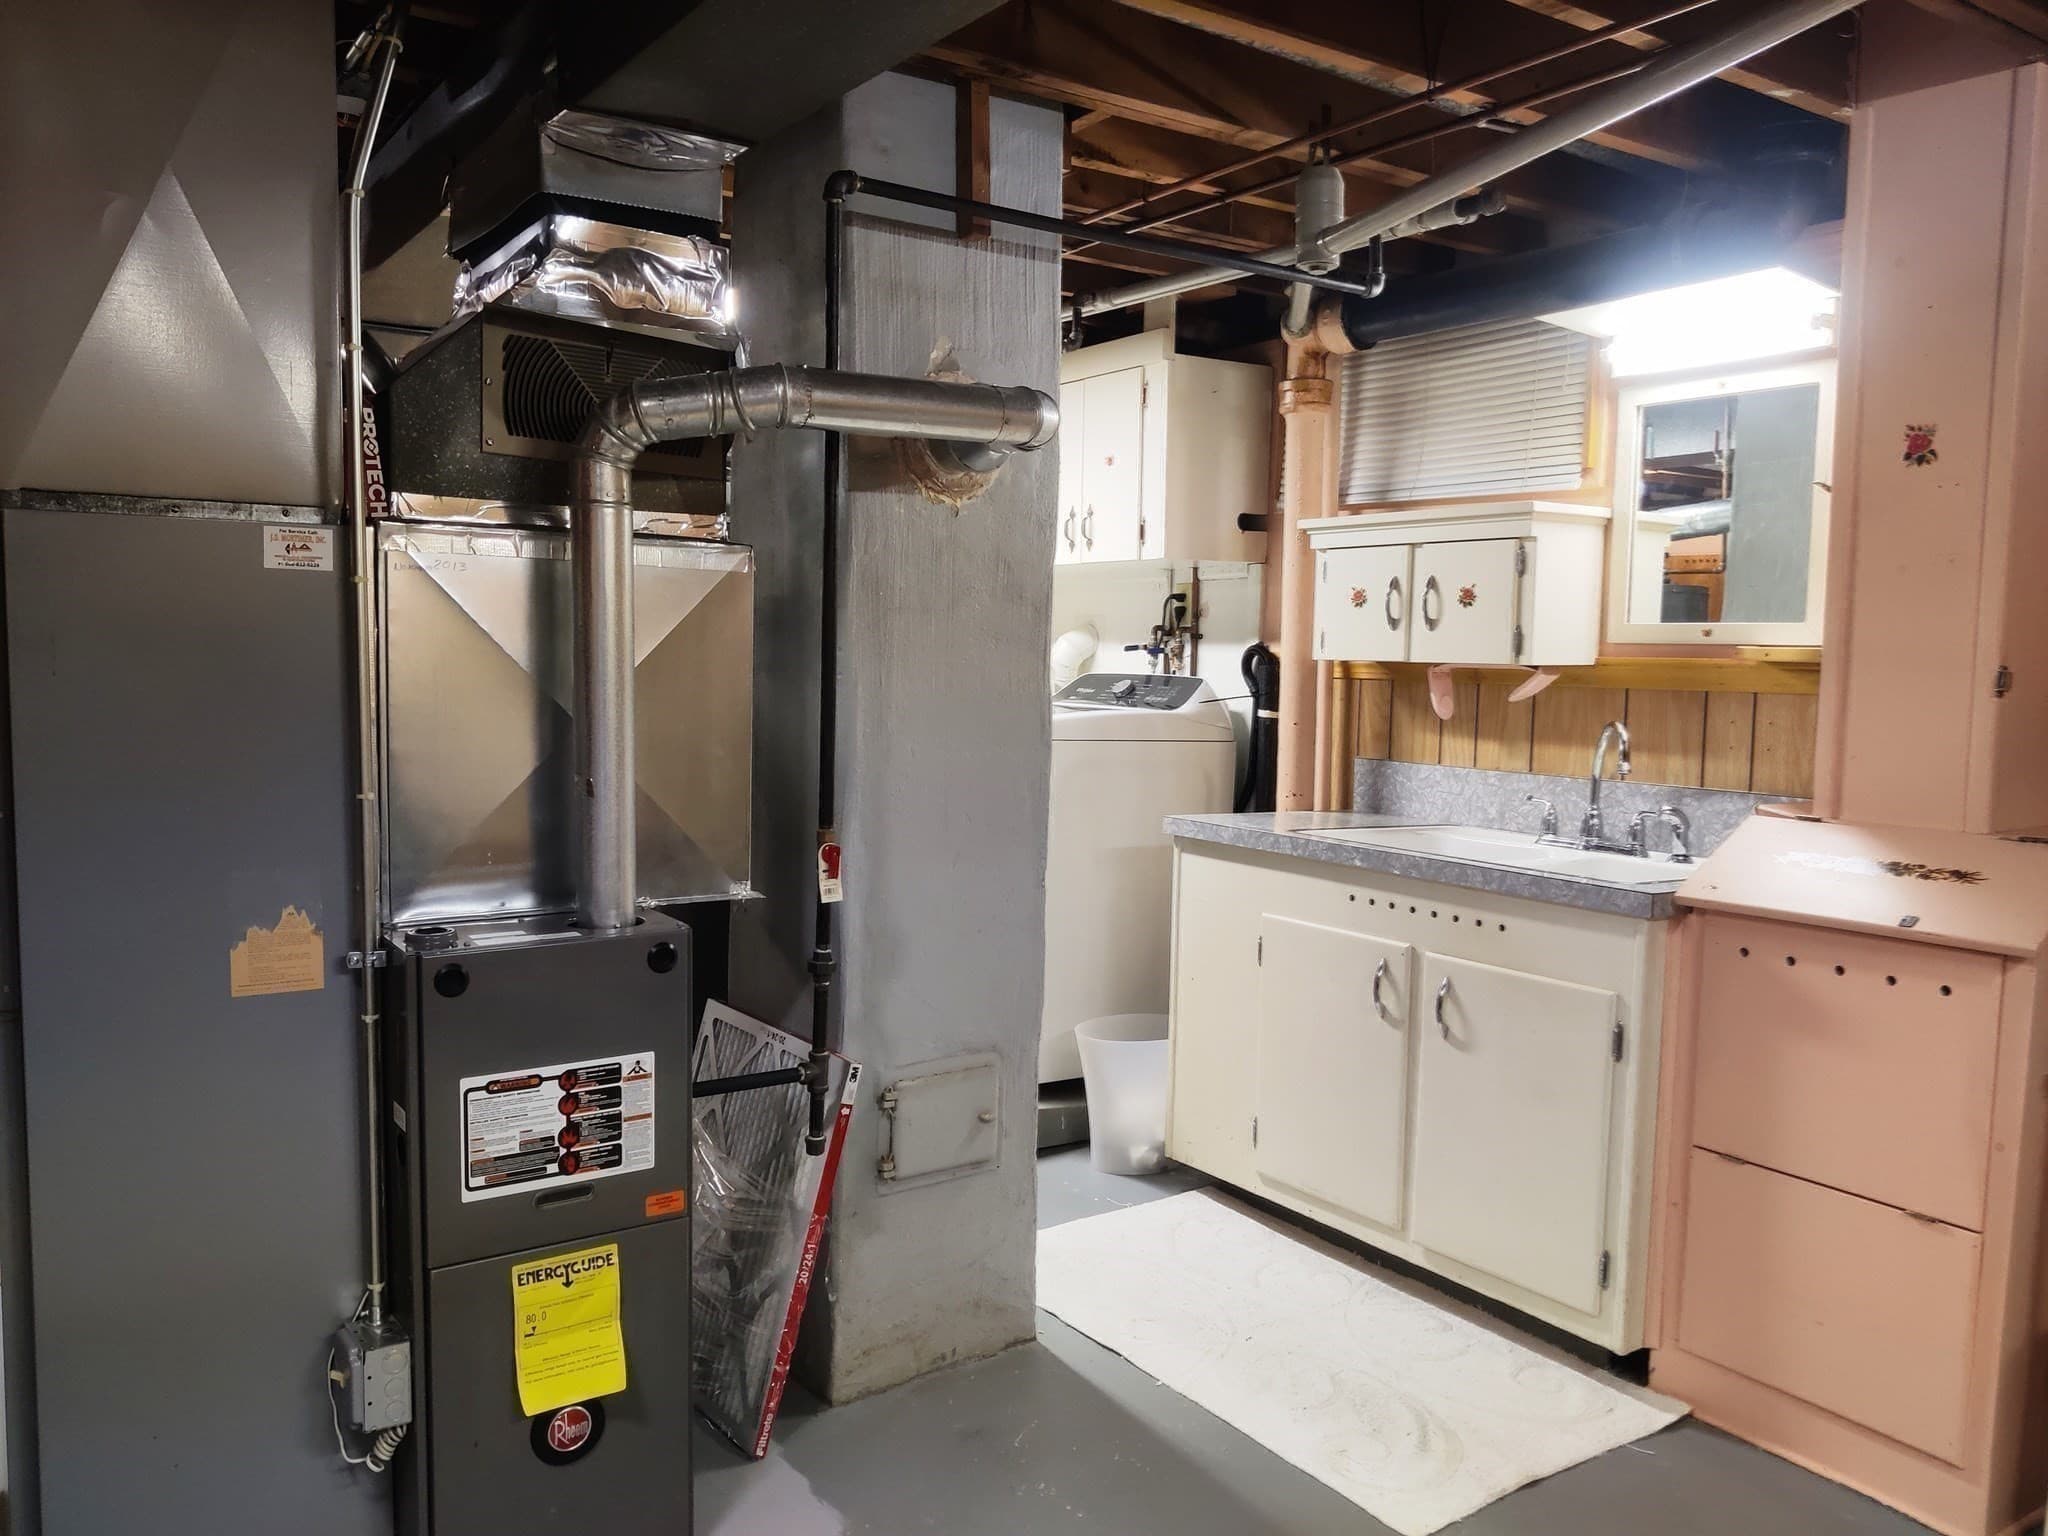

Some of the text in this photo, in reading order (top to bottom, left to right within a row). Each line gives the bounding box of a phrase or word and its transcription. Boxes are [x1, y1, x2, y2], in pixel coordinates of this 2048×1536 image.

[362, 407, 389, 518] PROTECH
[849, 1066, 860, 1083] 3M
[525, 1310, 547, 1325] 80.0
[554, 1412, 588, 1446] Rheem
[755, 1412, 774, 1457] Filtrete
